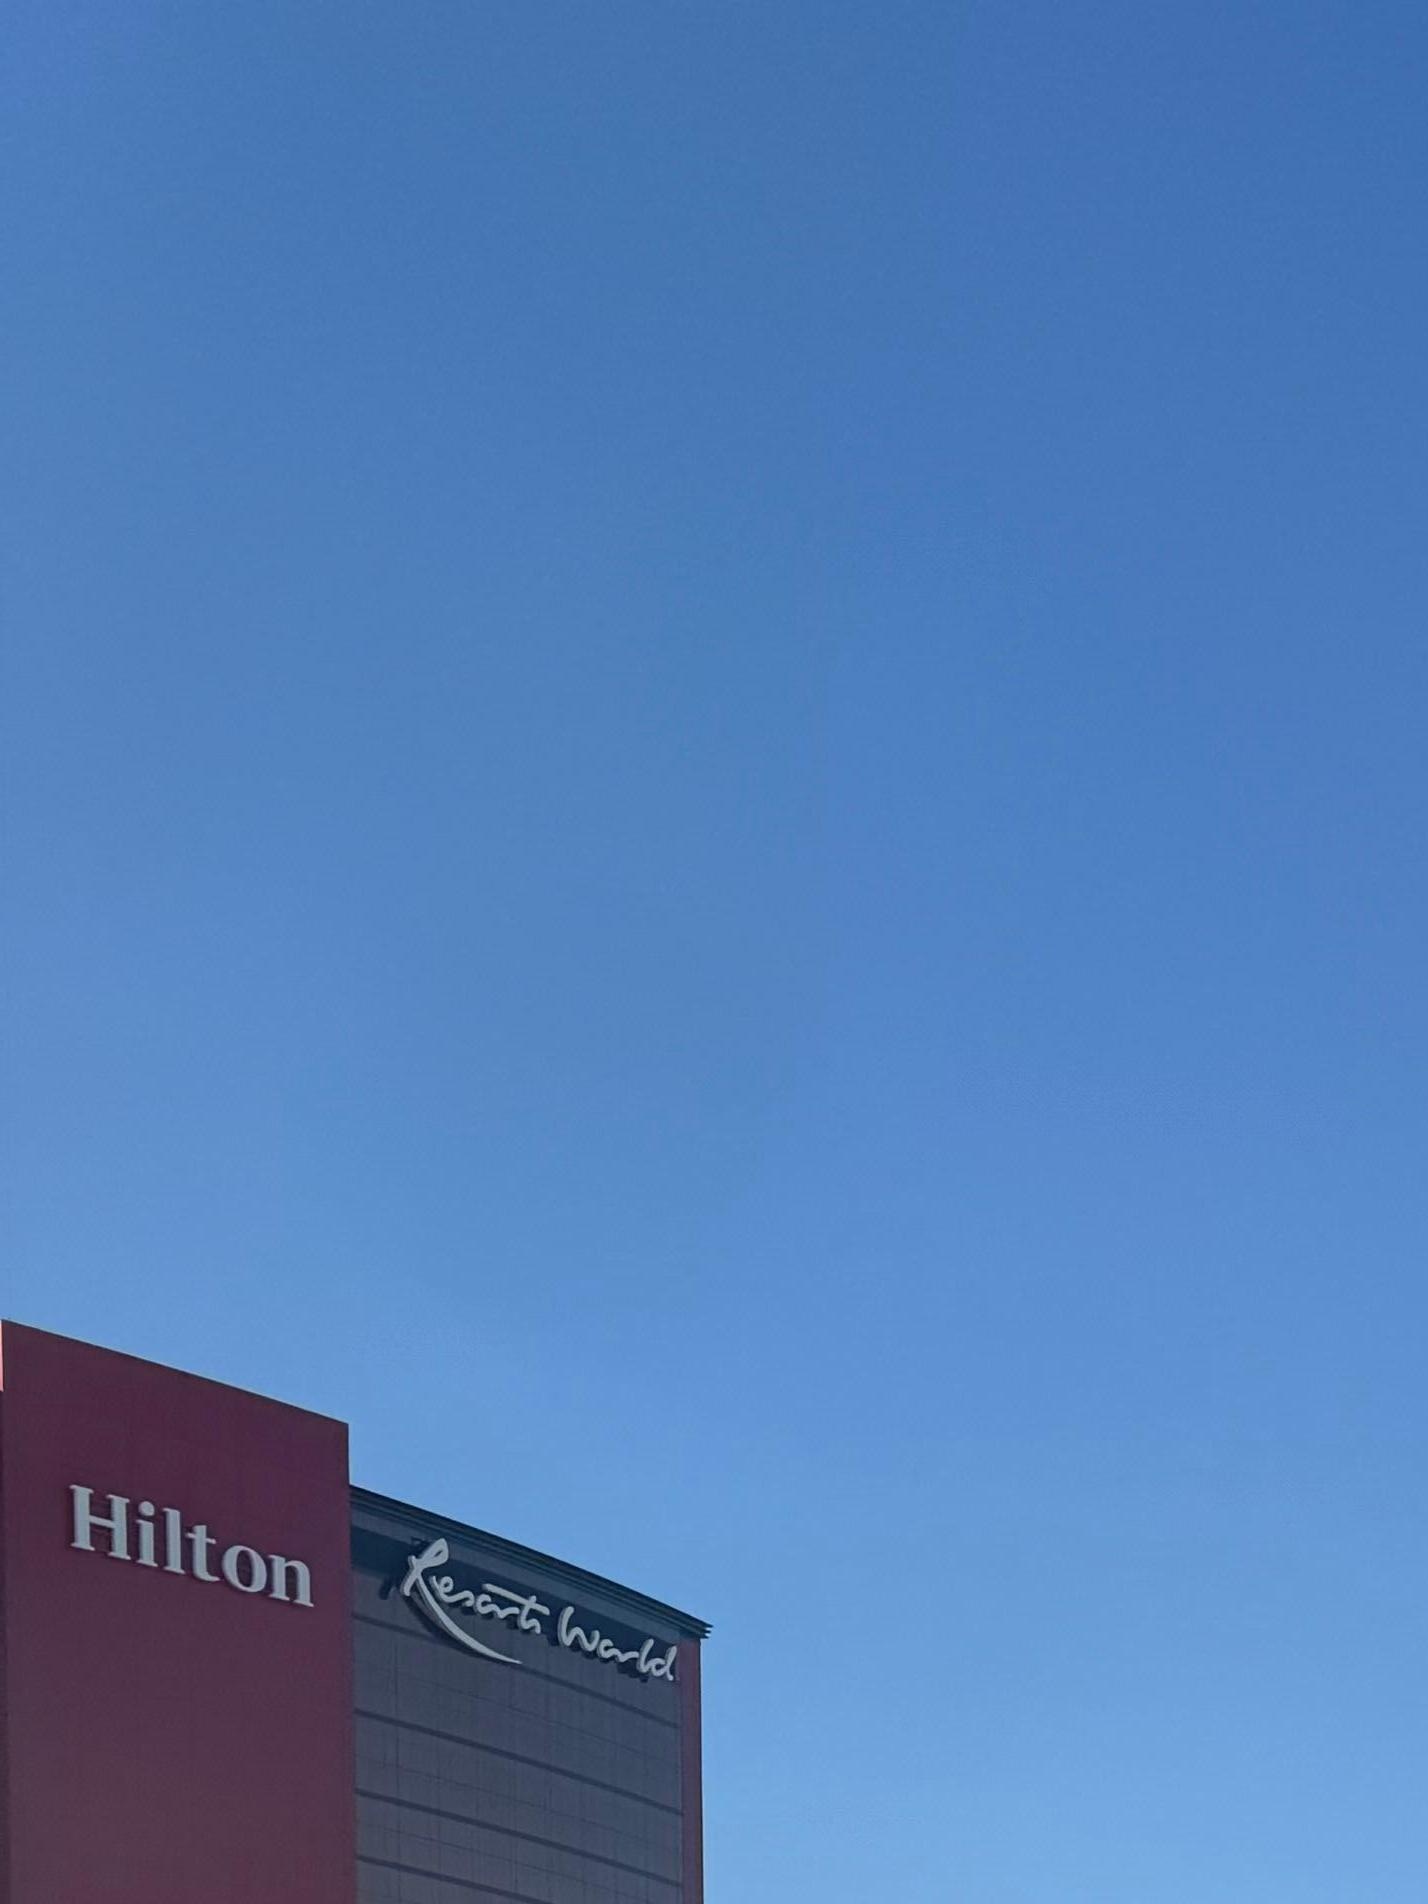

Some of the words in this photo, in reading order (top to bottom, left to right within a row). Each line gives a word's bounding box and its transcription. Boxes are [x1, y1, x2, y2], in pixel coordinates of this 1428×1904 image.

[69, 1484, 314, 1608] Hilton
[401, 1537, 550, 1663] Resorts
[557, 1606, 679, 1682] World
